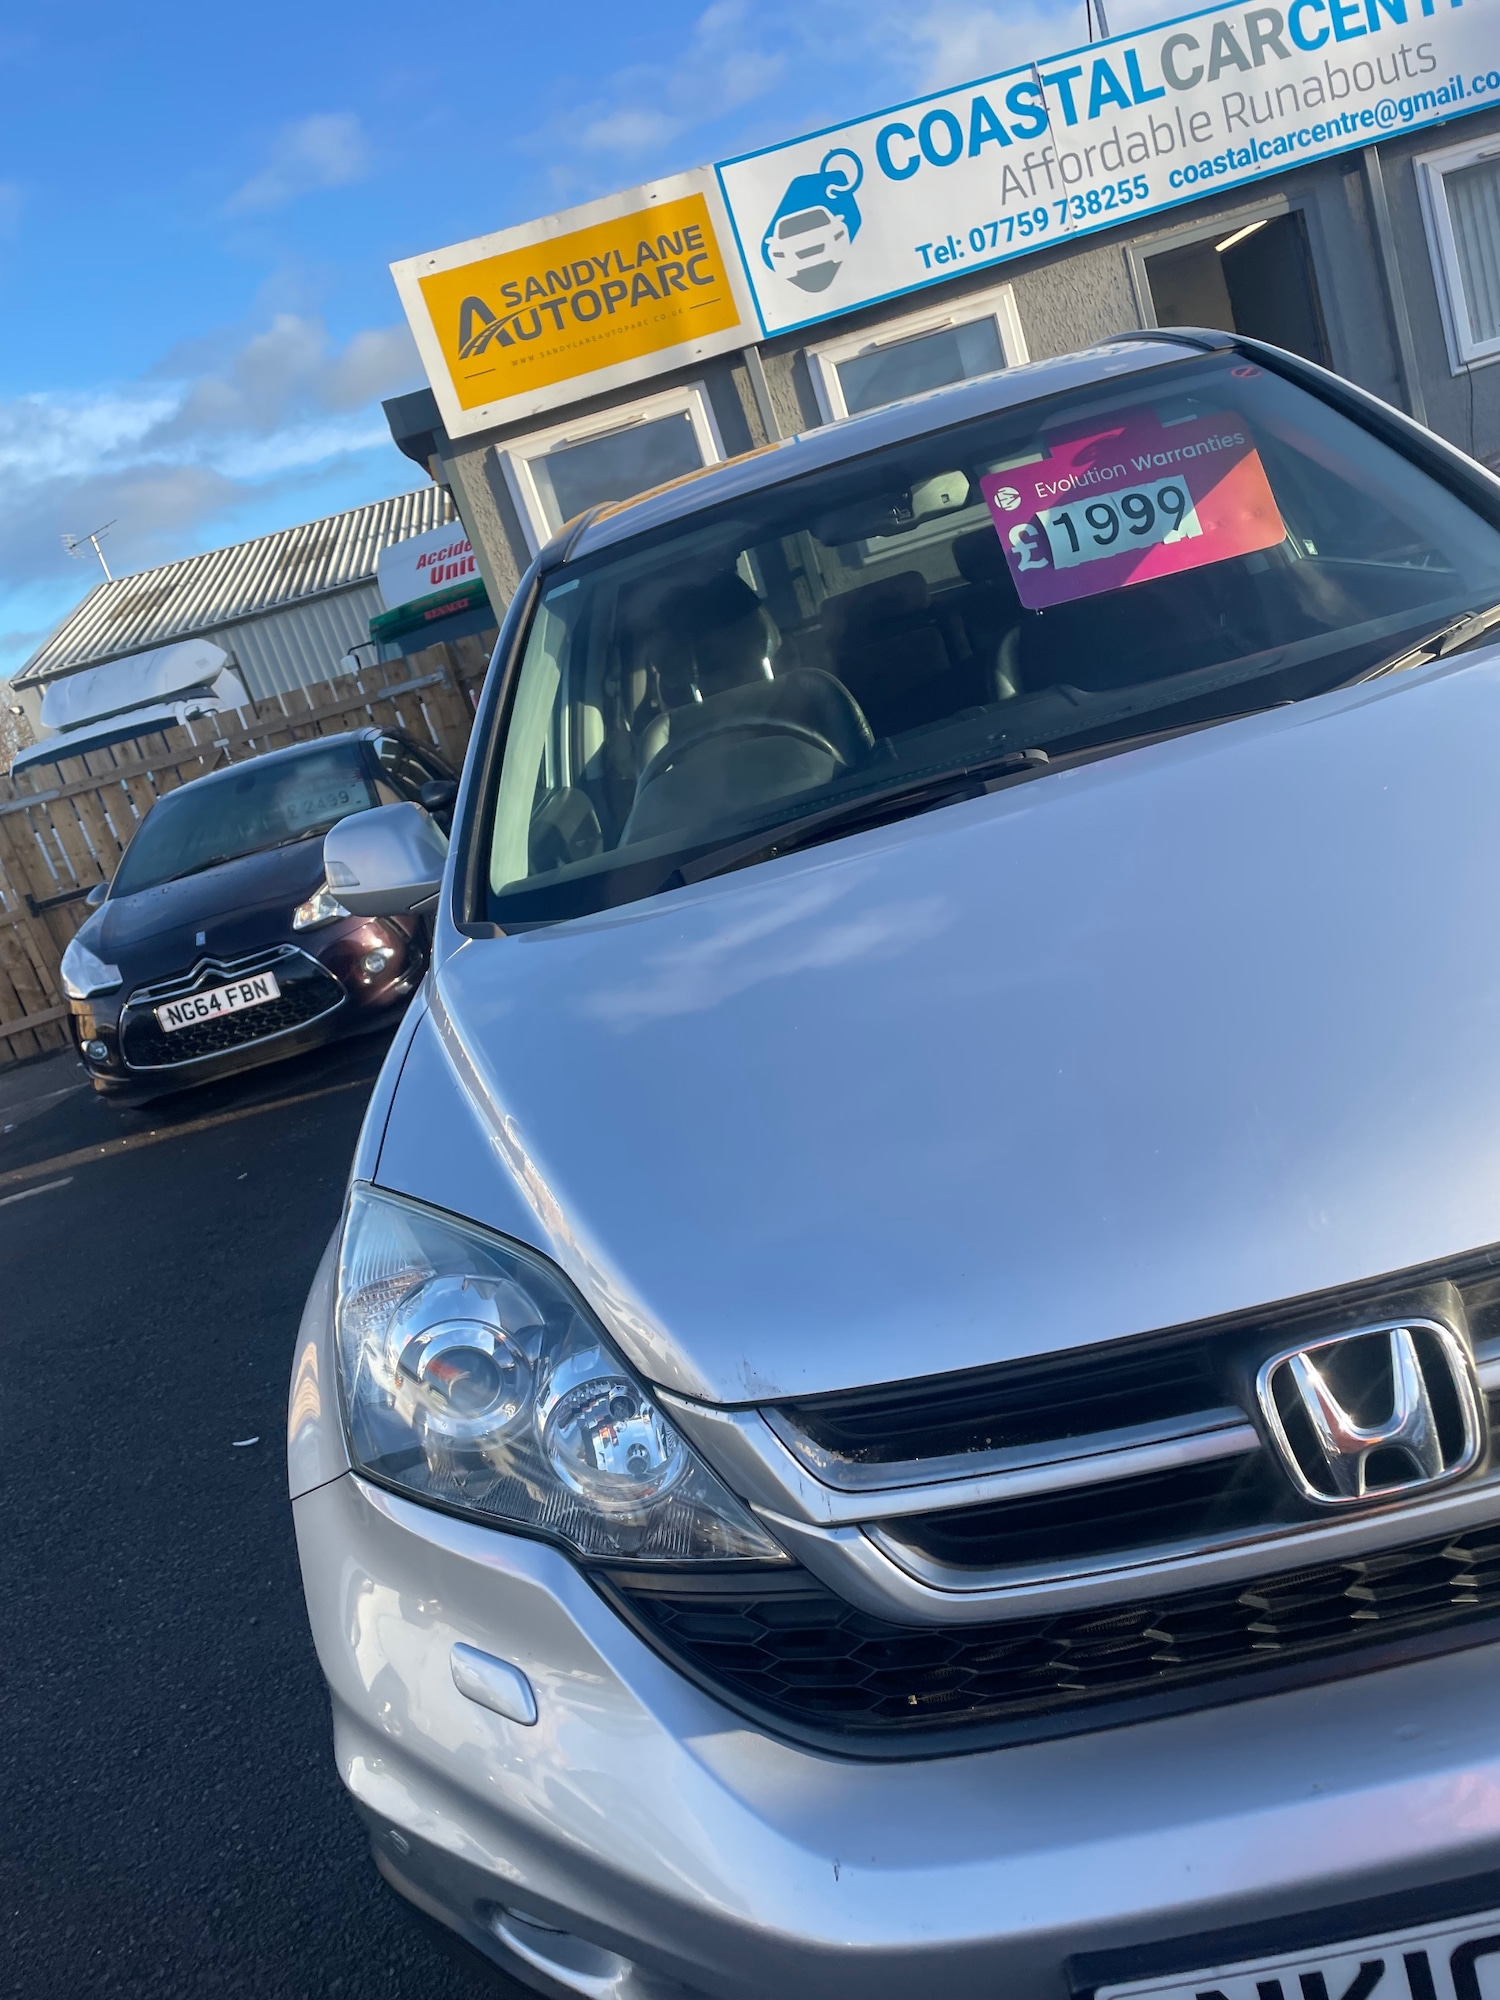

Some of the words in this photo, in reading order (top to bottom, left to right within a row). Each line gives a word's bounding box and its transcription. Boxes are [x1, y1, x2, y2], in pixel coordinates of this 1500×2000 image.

[999, 107, 1214, 206] Affordable
[1222, 41, 1437, 134] Runabouts
[915, 233, 967, 270] Tel:
[968, 206, 1050, 254] 07759
[1053, 174, 1150, 229] 738255
[458, 253, 715, 360] AUTOPARC
[500, 224, 705, 308] SANDYLANE
[1034, 458, 1127, 498] Evolution
[1131, 430, 1246, 472] Warranties
[429, 555, 477, 585] Unit
[167, 993, 222, 1026] NG64
[224, 977, 270, 1007] FBN
